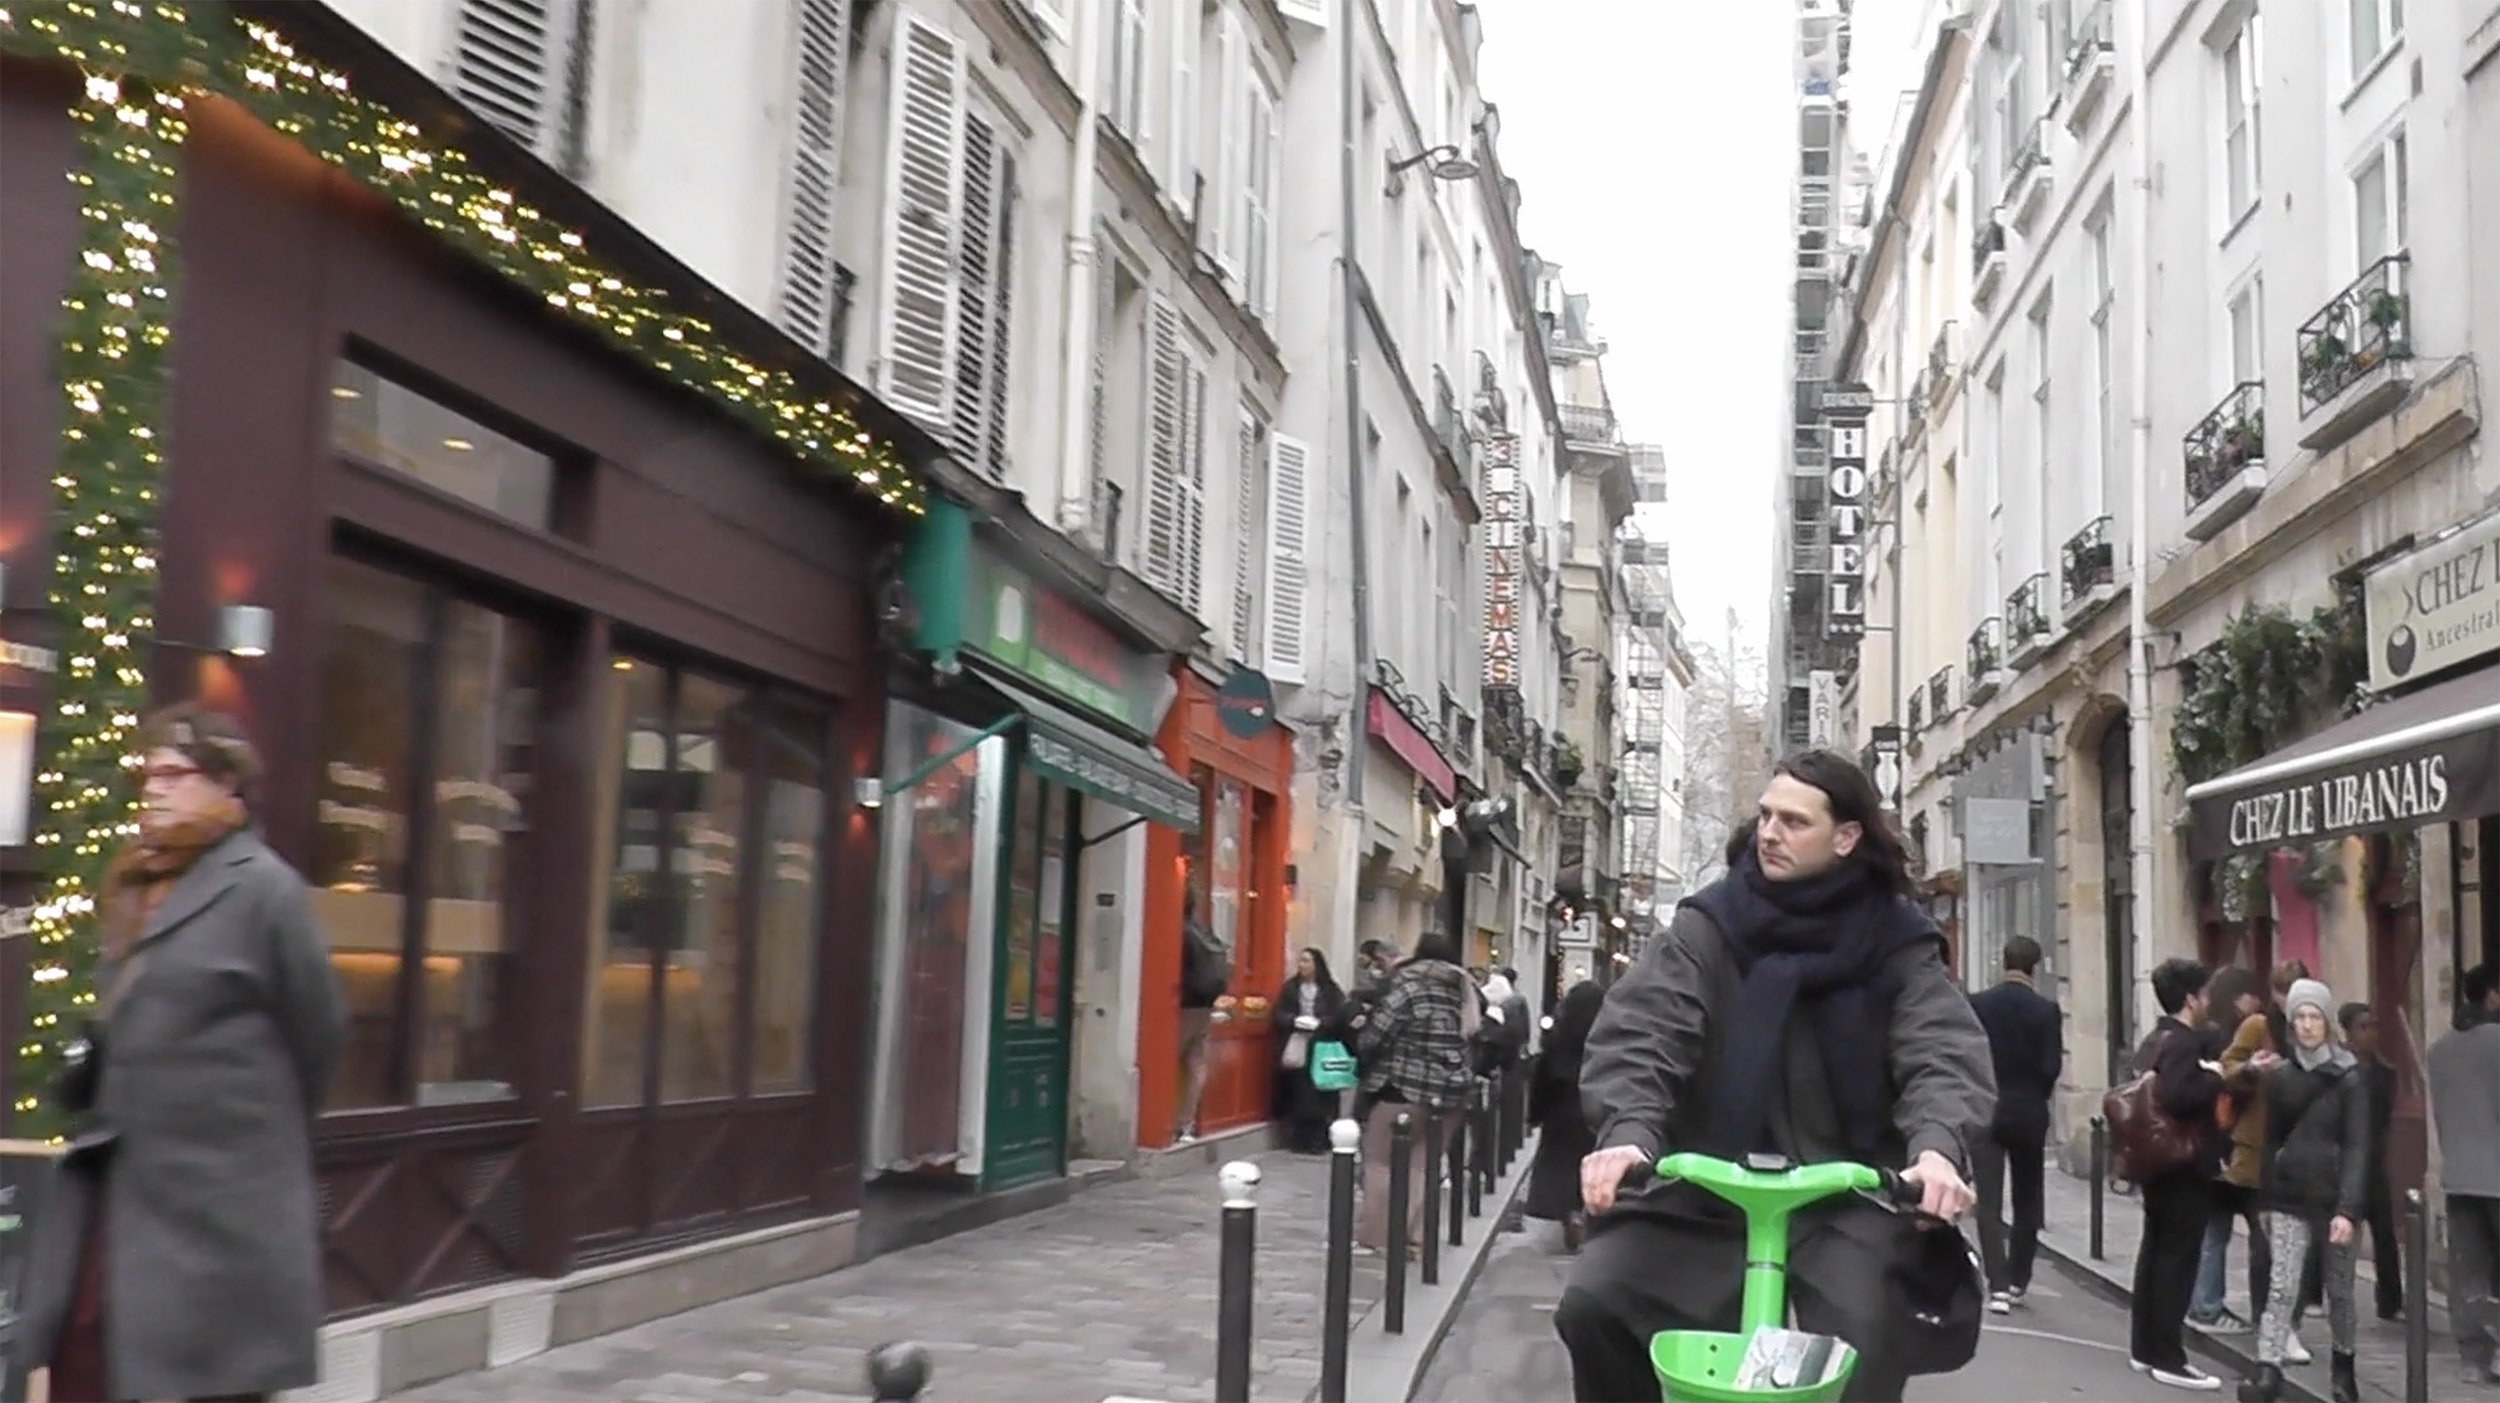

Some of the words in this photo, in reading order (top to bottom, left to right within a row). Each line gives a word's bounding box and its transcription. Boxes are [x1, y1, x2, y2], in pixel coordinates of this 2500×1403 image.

[1491, 496, 1514, 683] CINEMAS
[1830, 427, 1865, 615] HOTEL
[2415, 544, 2484, 616] CHEZ
[2229, 792, 2285, 847] CHEZ
[2287, 785, 2315, 837] LE
[2321, 754, 2448, 831] LIBANAIS
